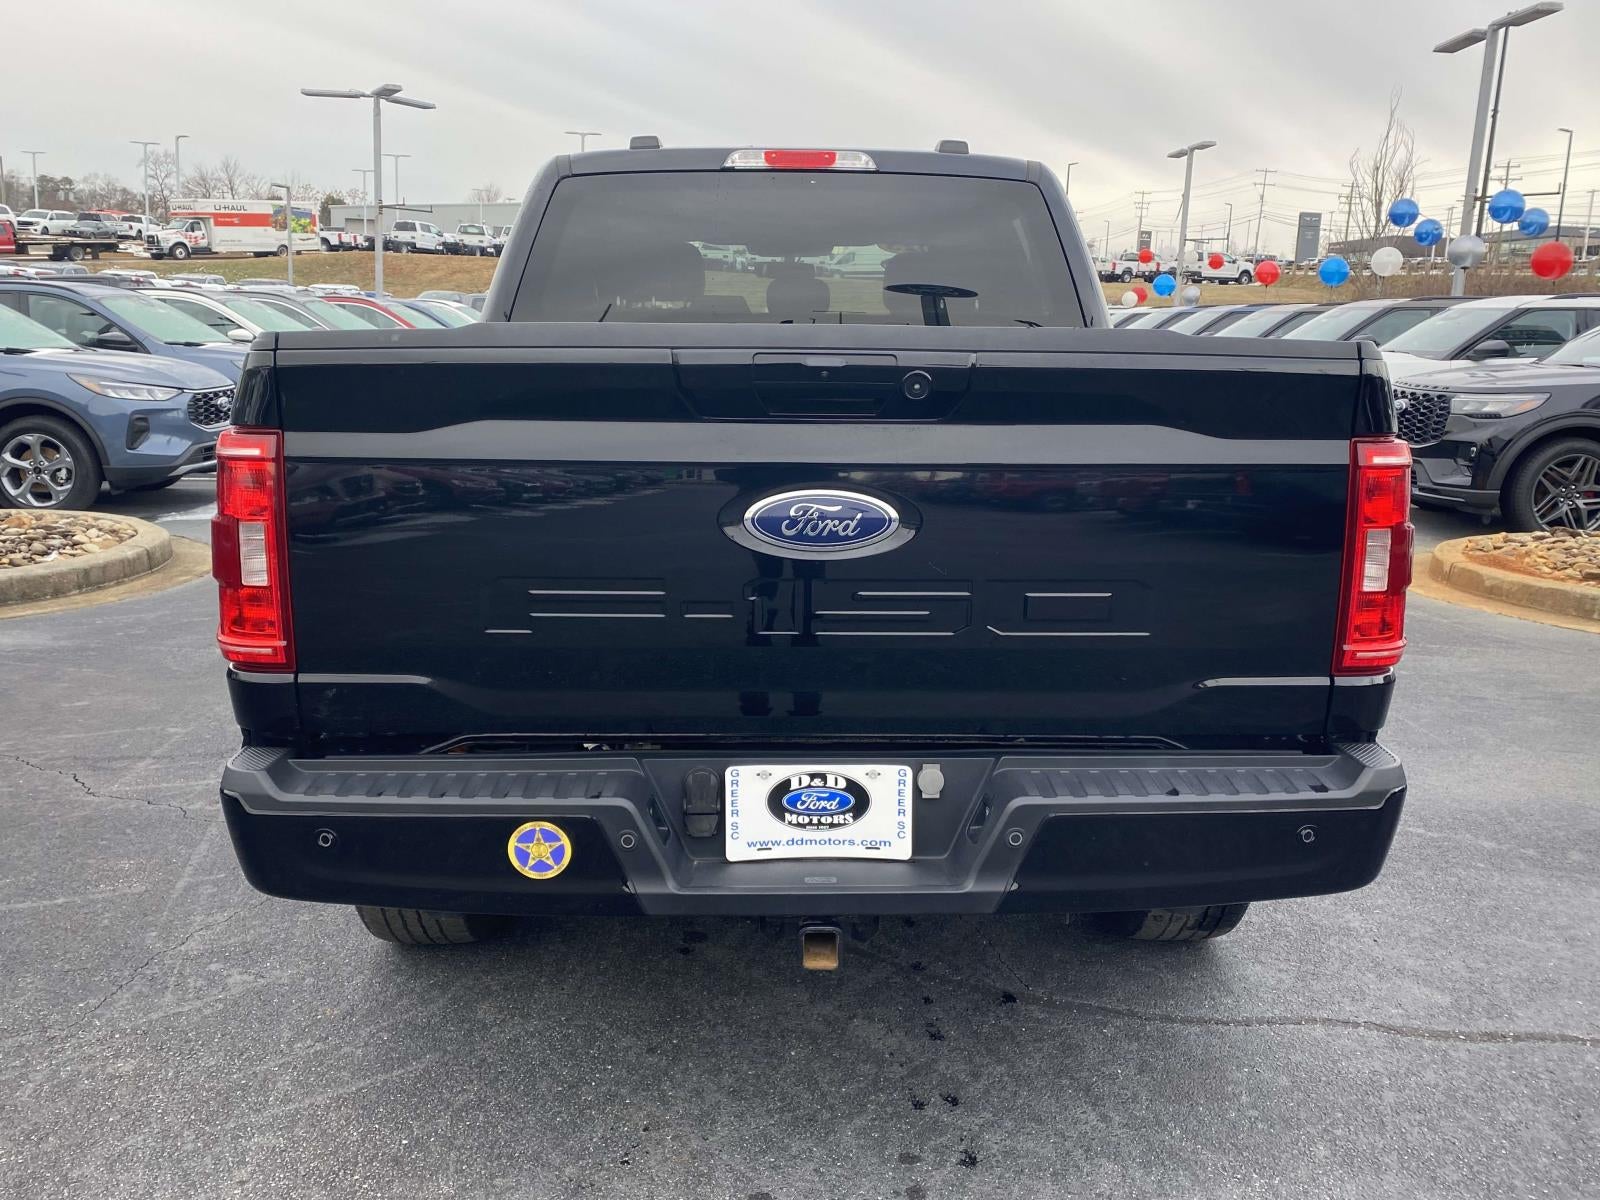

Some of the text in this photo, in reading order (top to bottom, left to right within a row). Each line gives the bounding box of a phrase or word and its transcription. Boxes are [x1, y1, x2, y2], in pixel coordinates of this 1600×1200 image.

[214, 204, 247, 212] U-HAUL
[781, 502, 862, 537] Ford
[789, 773, 847, 790] D&D
[730, 769, 740, 840] GREER SC
[796, 792, 840, 809] Ford
[897, 769, 907, 839] GREER SC
[784, 812, 854, 825] MOTORS
[747, 837, 892, 848] www.ddmotors.com
